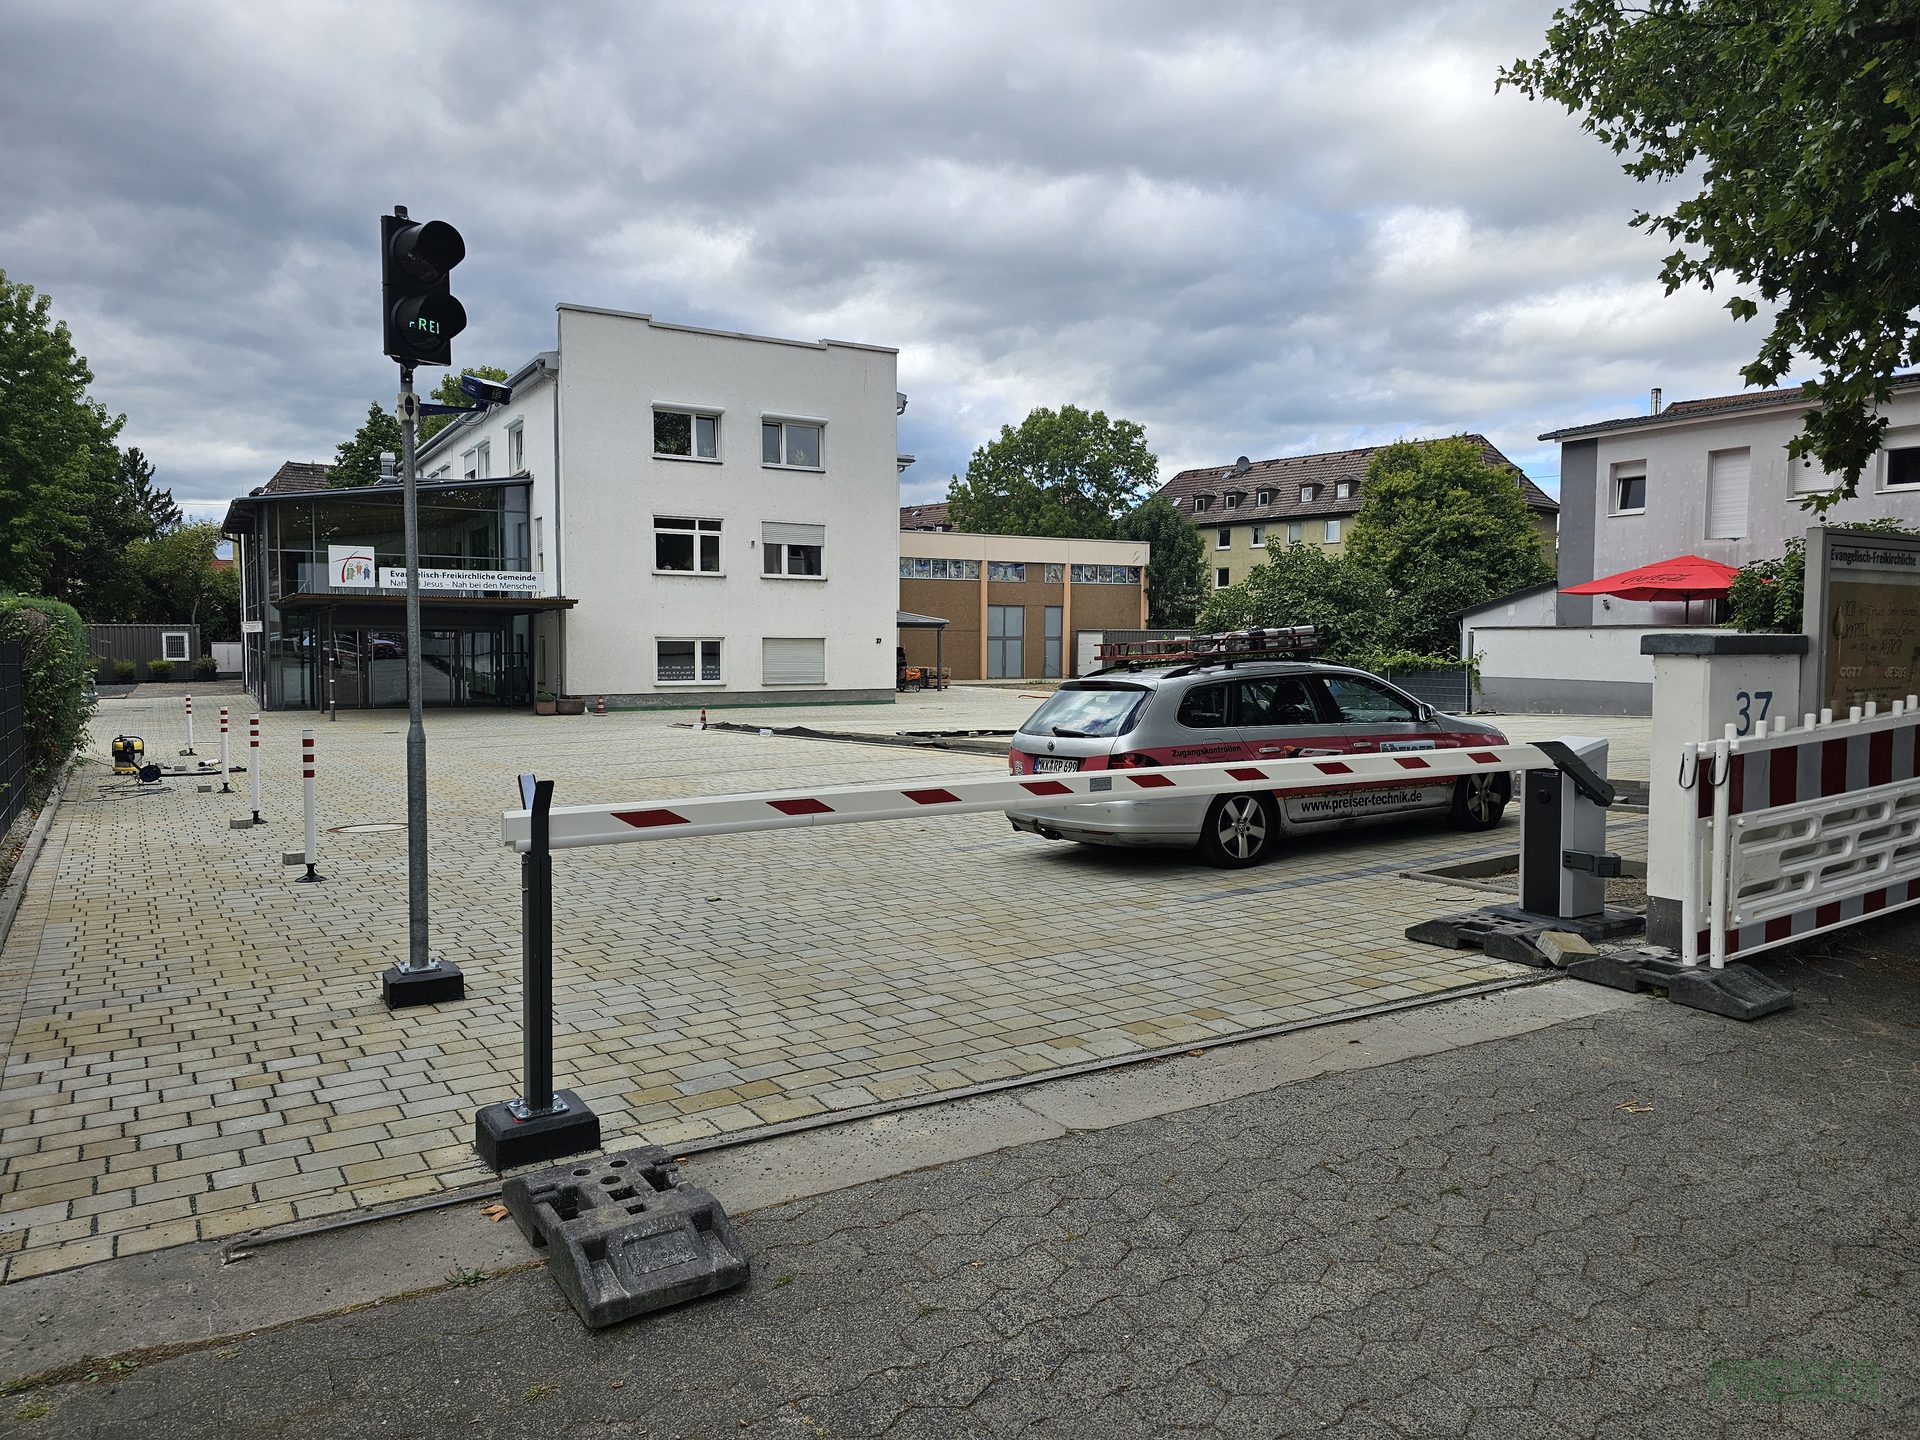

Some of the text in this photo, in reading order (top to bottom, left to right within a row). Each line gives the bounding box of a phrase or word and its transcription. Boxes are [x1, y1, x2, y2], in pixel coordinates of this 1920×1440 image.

[1831, 549, 1917, 567] Evangelisch-Freikirchliche
[390, 570, 537, 581] Evaelisch-Freikirchliche Gemeinde
[390, 579, 406, 587] Nah
[423, 580, 443, 588] Jesus
[452, 581, 467, 589] Nah
[469, 581, 481, 589] bei
[483, 581, 498, 589] den
[500, 582, 537, 590] Menschen
[1736, 690, 1773, 737] 37
[1172, 745, 1242, 758] Zugangskontrollen
[1301, 789, 1422, 813] www.preiser-technik.de
